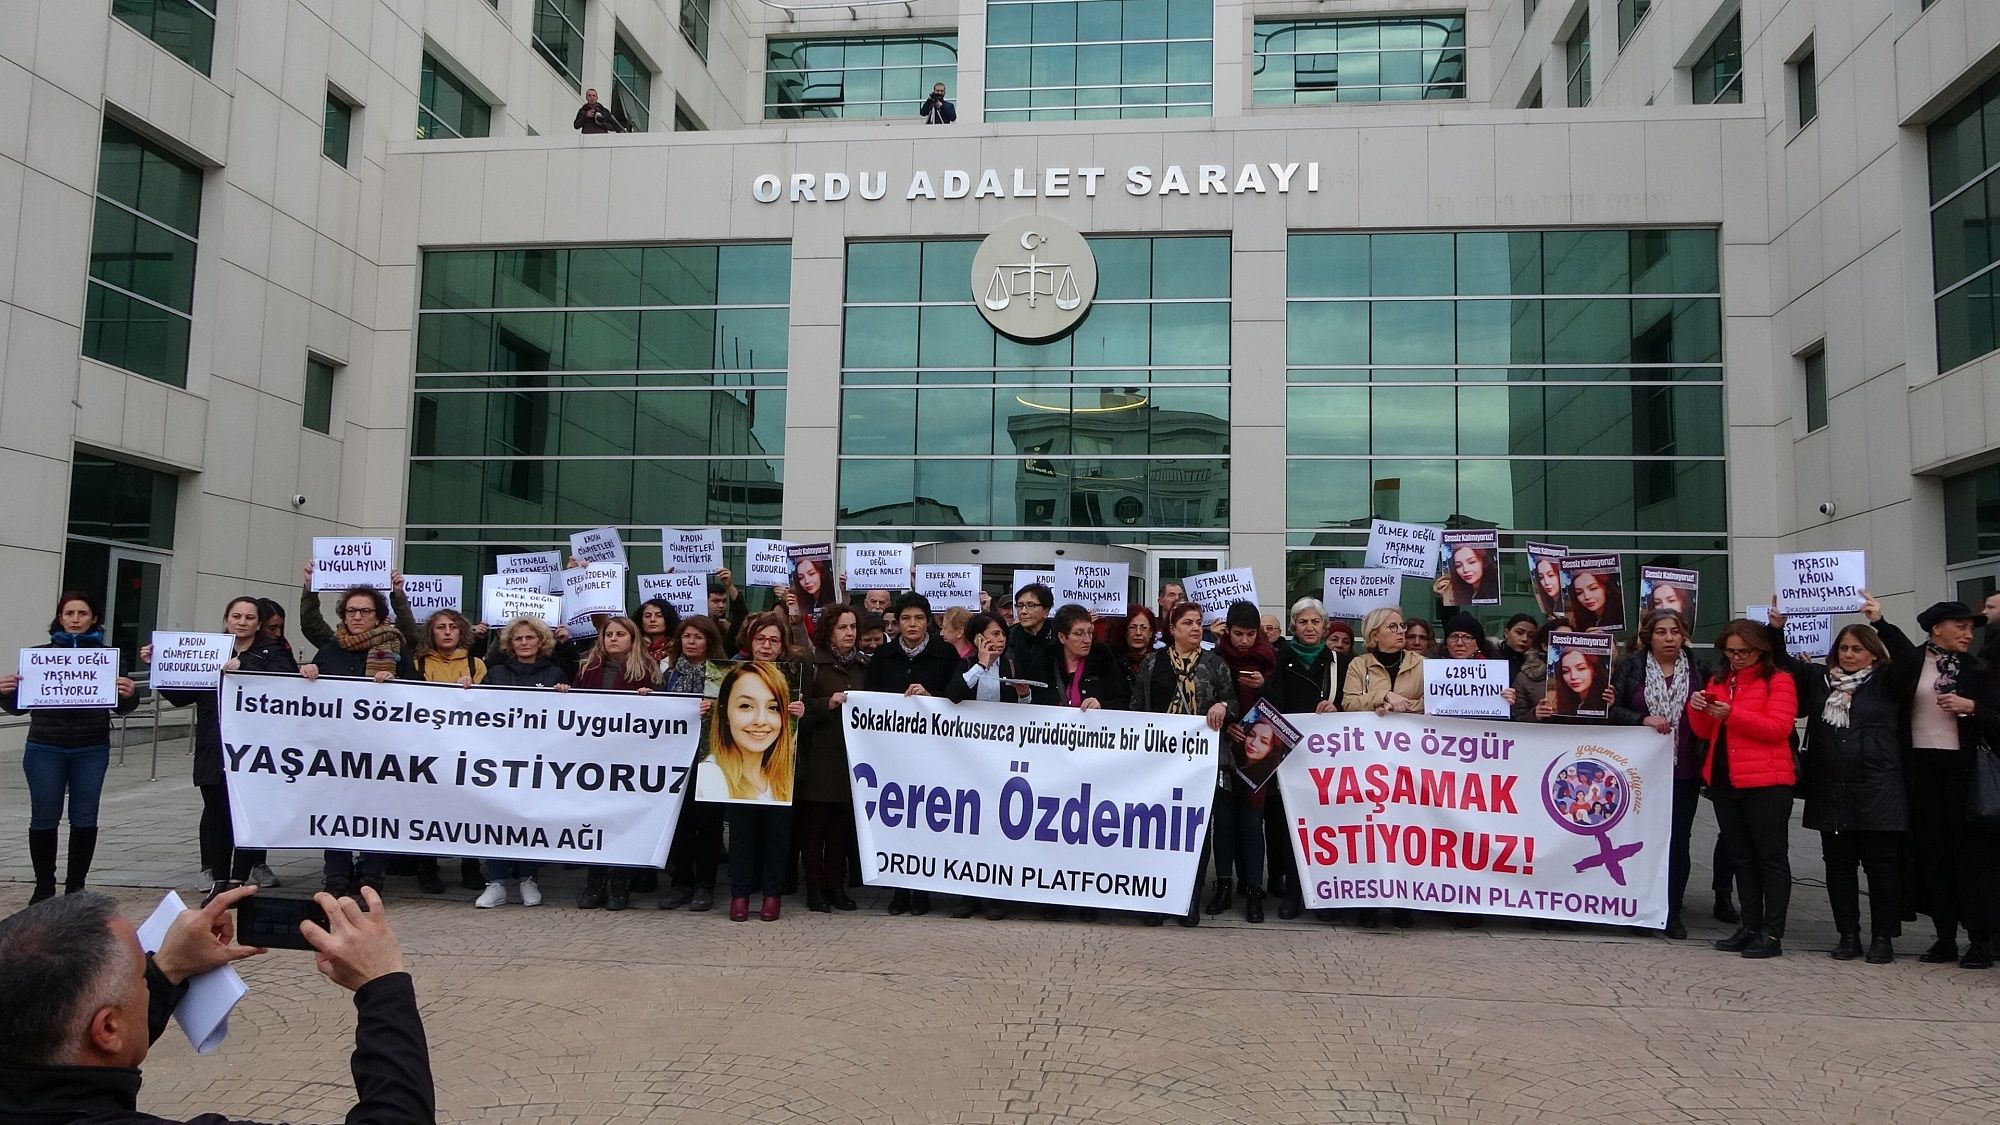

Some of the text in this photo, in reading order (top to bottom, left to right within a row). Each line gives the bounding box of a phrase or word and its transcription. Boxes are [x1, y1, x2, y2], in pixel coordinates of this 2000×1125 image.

[752, 161, 1320, 203] ORDU ADALET SARAYI
[680, 534, 703, 542] KADIN
[1378, 524, 1436, 542] ÖLMEK DEĞİL
[334, 542, 372, 556] 6284'Ü
[577, 539, 615, 555] CİNAYETLERİ
[670, 541, 715, 553] CİNAYETLERİ
[1385, 541, 1425, 555] YAŞAMAK
[510, 556, 548, 566] İSTANBUL
[673, 553, 713, 563] POLİTİKTİR
[870, 558, 887, 566] DEĞİL
[1382, 553, 1425, 568] İSTİYORUZ
[319, 560, 386, 572] UYGULAYIN!
[1792, 557, 1839, 574] YAŞASIN
[585, 569, 618, 580] ÖZDEMİR
[854, 568, 877, 577] GERÇEK
[1074, 566, 1110, 579] YAŞASIN
[1799, 572, 1834, 585] KADIN
[405, 579, 442, 592] 6284'Ü
[506, 577, 528, 585] KADIN
[643, 575, 701, 588] ÖLMEK DEĞİL
[939, 580, 956, 588] DEĞİL
[1077, 579, 1105, 588] KADIN
[1195, 573, 1239, 589] İSTANBUL
[1330, 574, 1395, 585] CEREN ÖZDEMİR
[496, 592, 525, 600] ÖLMEK
[924, 590, 947, 599] GERÇEK
[1063, 590, 1121, 604] DAYANIŞMASI
[1191, 581, 1253, 602] SÖZLEŞMESİ'Nİ
[1339, 587, 1389, 599] İÇİN ADALET
[1782, 586, 1857, 601] DAYANIŞMASI
[504, 601, 544, 609] YAŞAMAK
[178, 637, 206, 646] KADIN
[1552, 636, 1608, 647] Sessiz Kalmıyoruz!
[31, 653, 111, 665] ÖLMEK DEĞİL
[163, 649, 219, 659] CİNAYETLERİ
[43, 670, 97, 684] YAŞAMAK
[1446, 664, 1487, 679] 6284'Ü
[41, 683, 99, 696] İSTİYORUZ
[235, 686, 688, 741] İstanbul Sözleşmesi’ni Uygulayın
[850, 706, 1209, 761] Sokaklarda Korkusuzca yürüdüğümüz bir Ülke için
[1307, 726, 1365, 759] eşit
[1375, 732, 1411, 752] ve
[1421, 728, 1515, 763] özgür
[224, 743, 691, 794] YAŞAMAK İSTİYORUZ
[1575, 744, 1628, 766] yaşamak
[1627, 768, 1643, 814] istiyoruz
[1308, 763, 1519, 815] YAŞAMAK
[999, 760, 1205, 853] Özdemir
[309, 814, 603, 851] KADIN SAVUNMA AĞI
[1297, 815, 1535, 876] İSTİYORUZ!
[876, 851, 1168, 898] ORDU KADIN PLATFORMU
[1316, 876, 1639, 918] GİRESUN KADIN PLATFORMU
